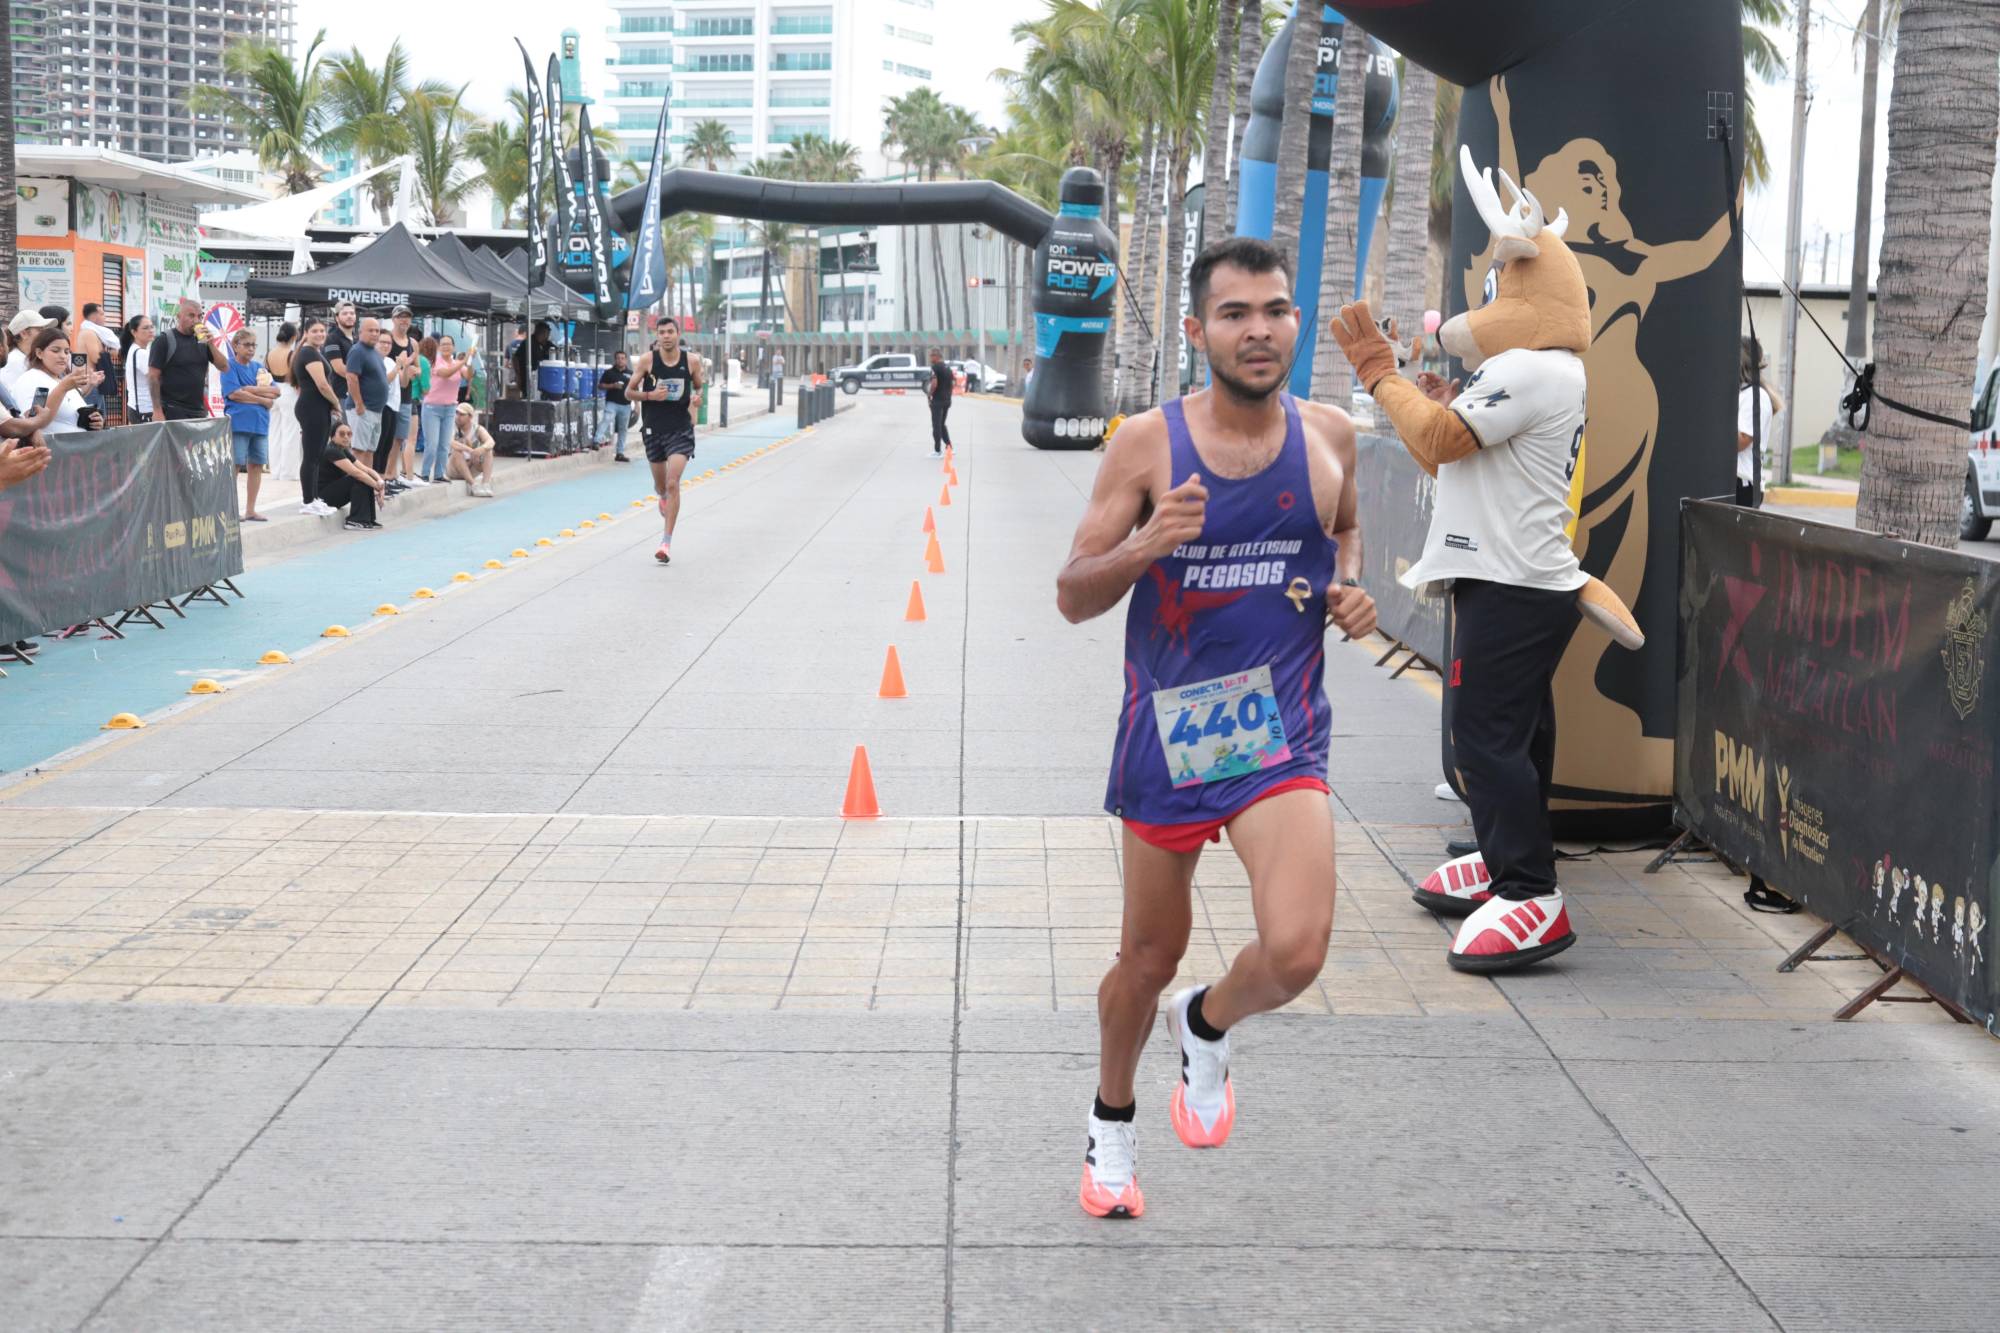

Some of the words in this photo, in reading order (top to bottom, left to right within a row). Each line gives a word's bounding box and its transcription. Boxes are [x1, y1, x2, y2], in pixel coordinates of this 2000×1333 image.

[29, 257, 41, 265] DE
[43, 257, 65, 266] COCO
[1048, 258, 1115, 277] POWER
[1047, 272, 1089, 289] ADE
[327, 288, 409, 305] POWERADE
[1173, 543, 1206, 560] CLUB
[1209, 544, 1226, 559] DE
[1228, 539, 1303, 558] ATLETISMO
[1182, 560, 1286, 589] PEGASOS
[1179, 681, 1223, 700] CONECTA
[1168, 691, 1267, 747] 440
[1714, 728, 1765, 822] PMM
